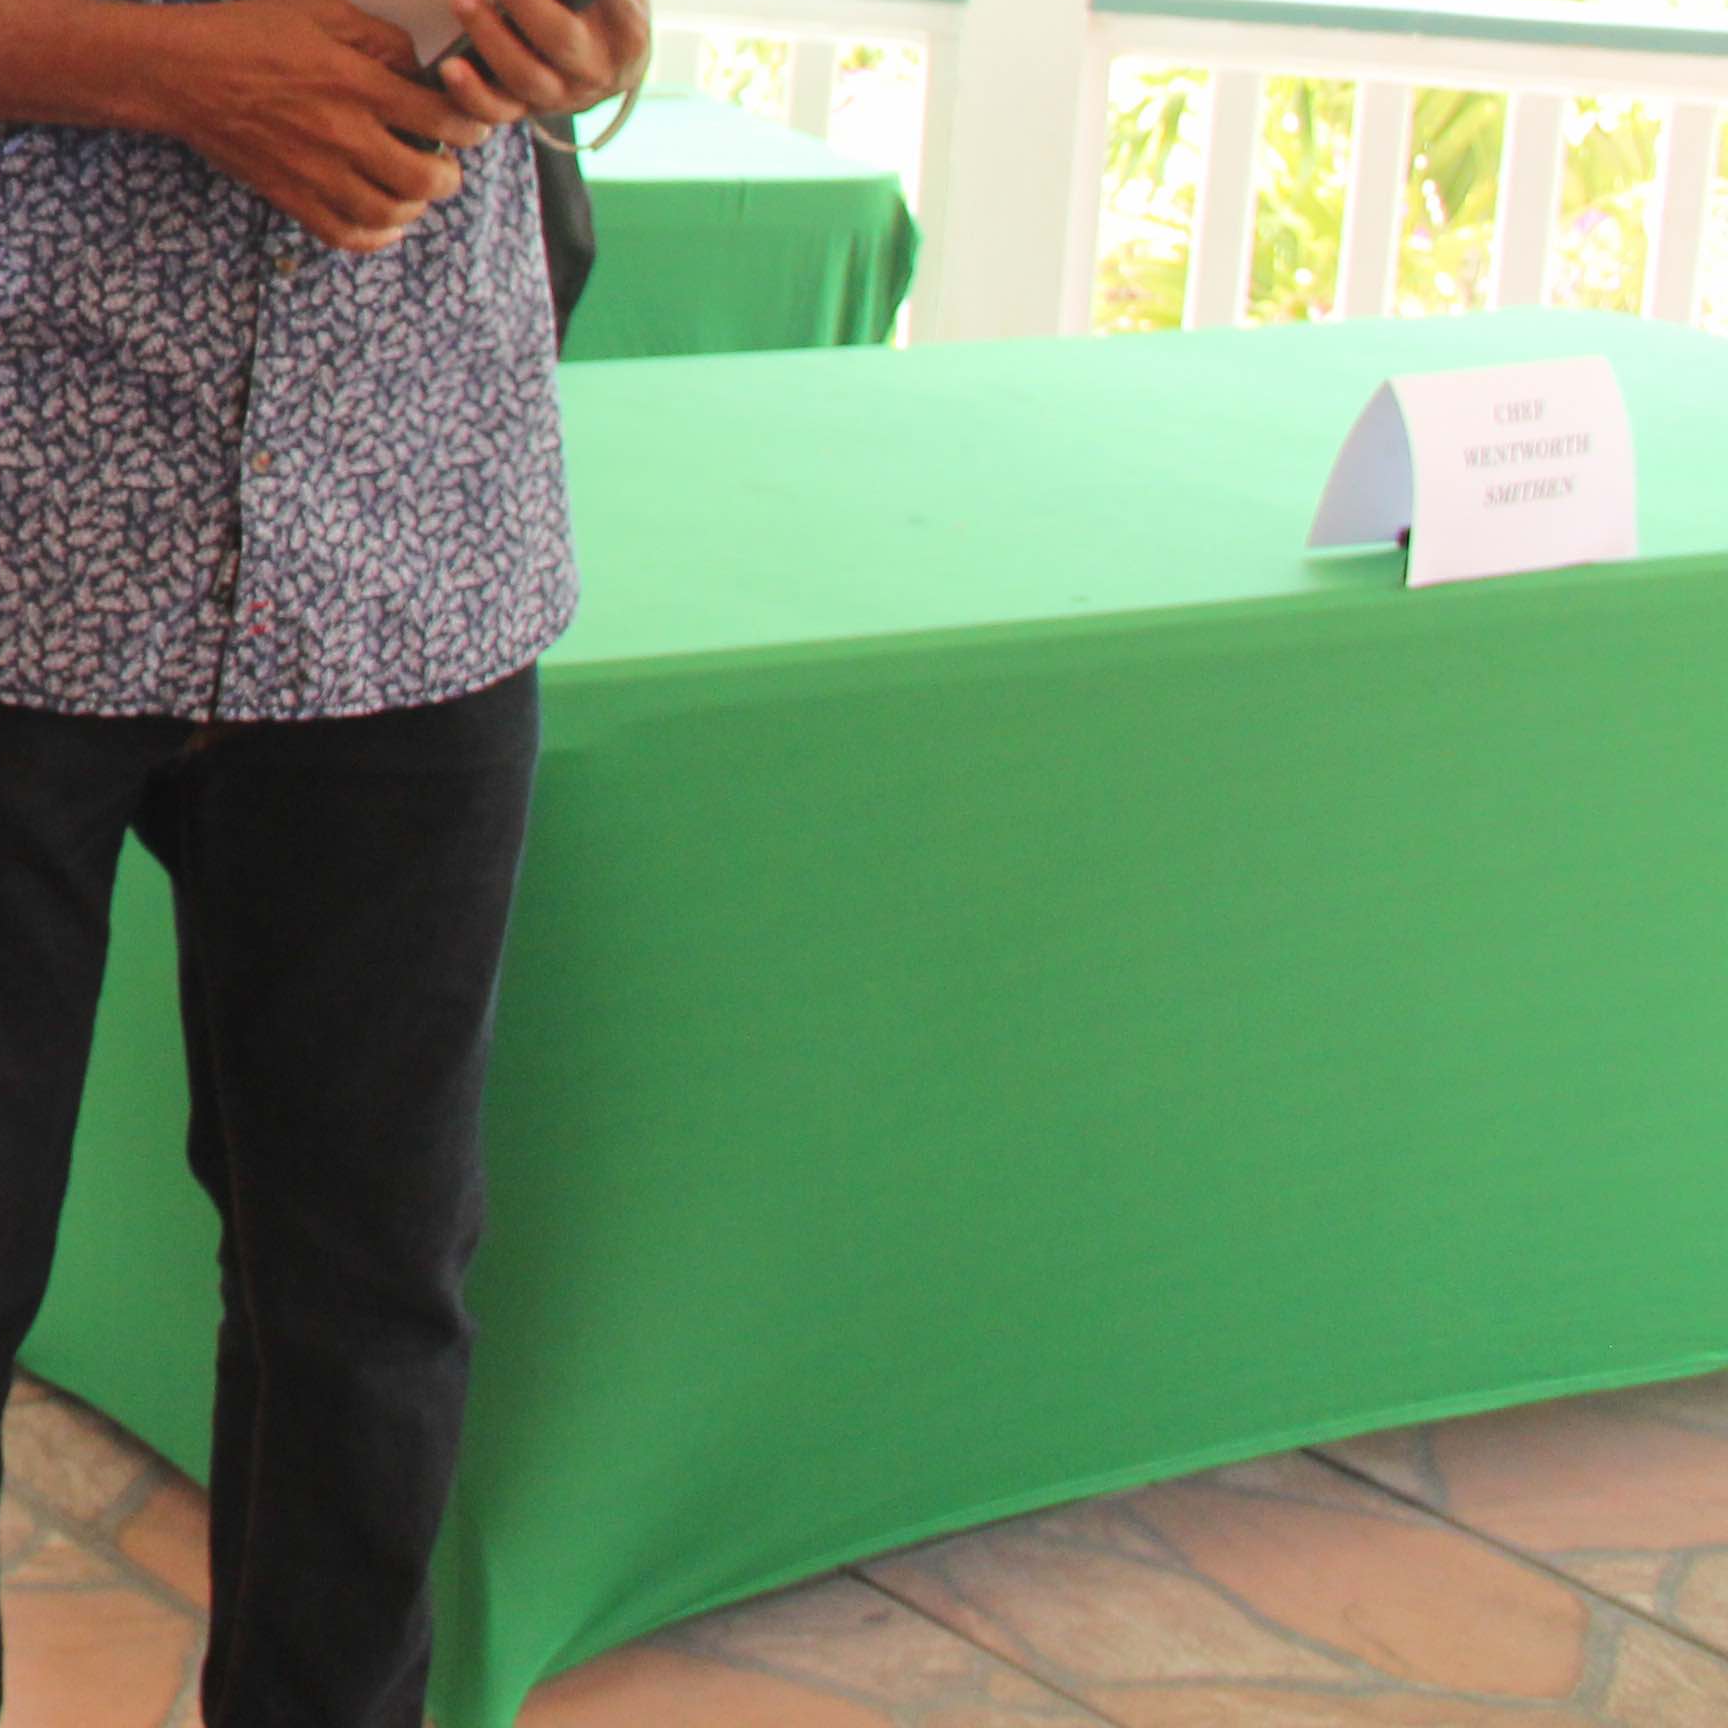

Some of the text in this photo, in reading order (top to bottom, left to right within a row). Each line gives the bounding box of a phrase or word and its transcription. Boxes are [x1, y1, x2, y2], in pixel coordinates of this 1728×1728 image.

[1492, 398, 1546, 425] CHEF
[1462, 432, 1592, 469] WENTWORTH
[1482, 475, 1575, 509] SMITHEN
